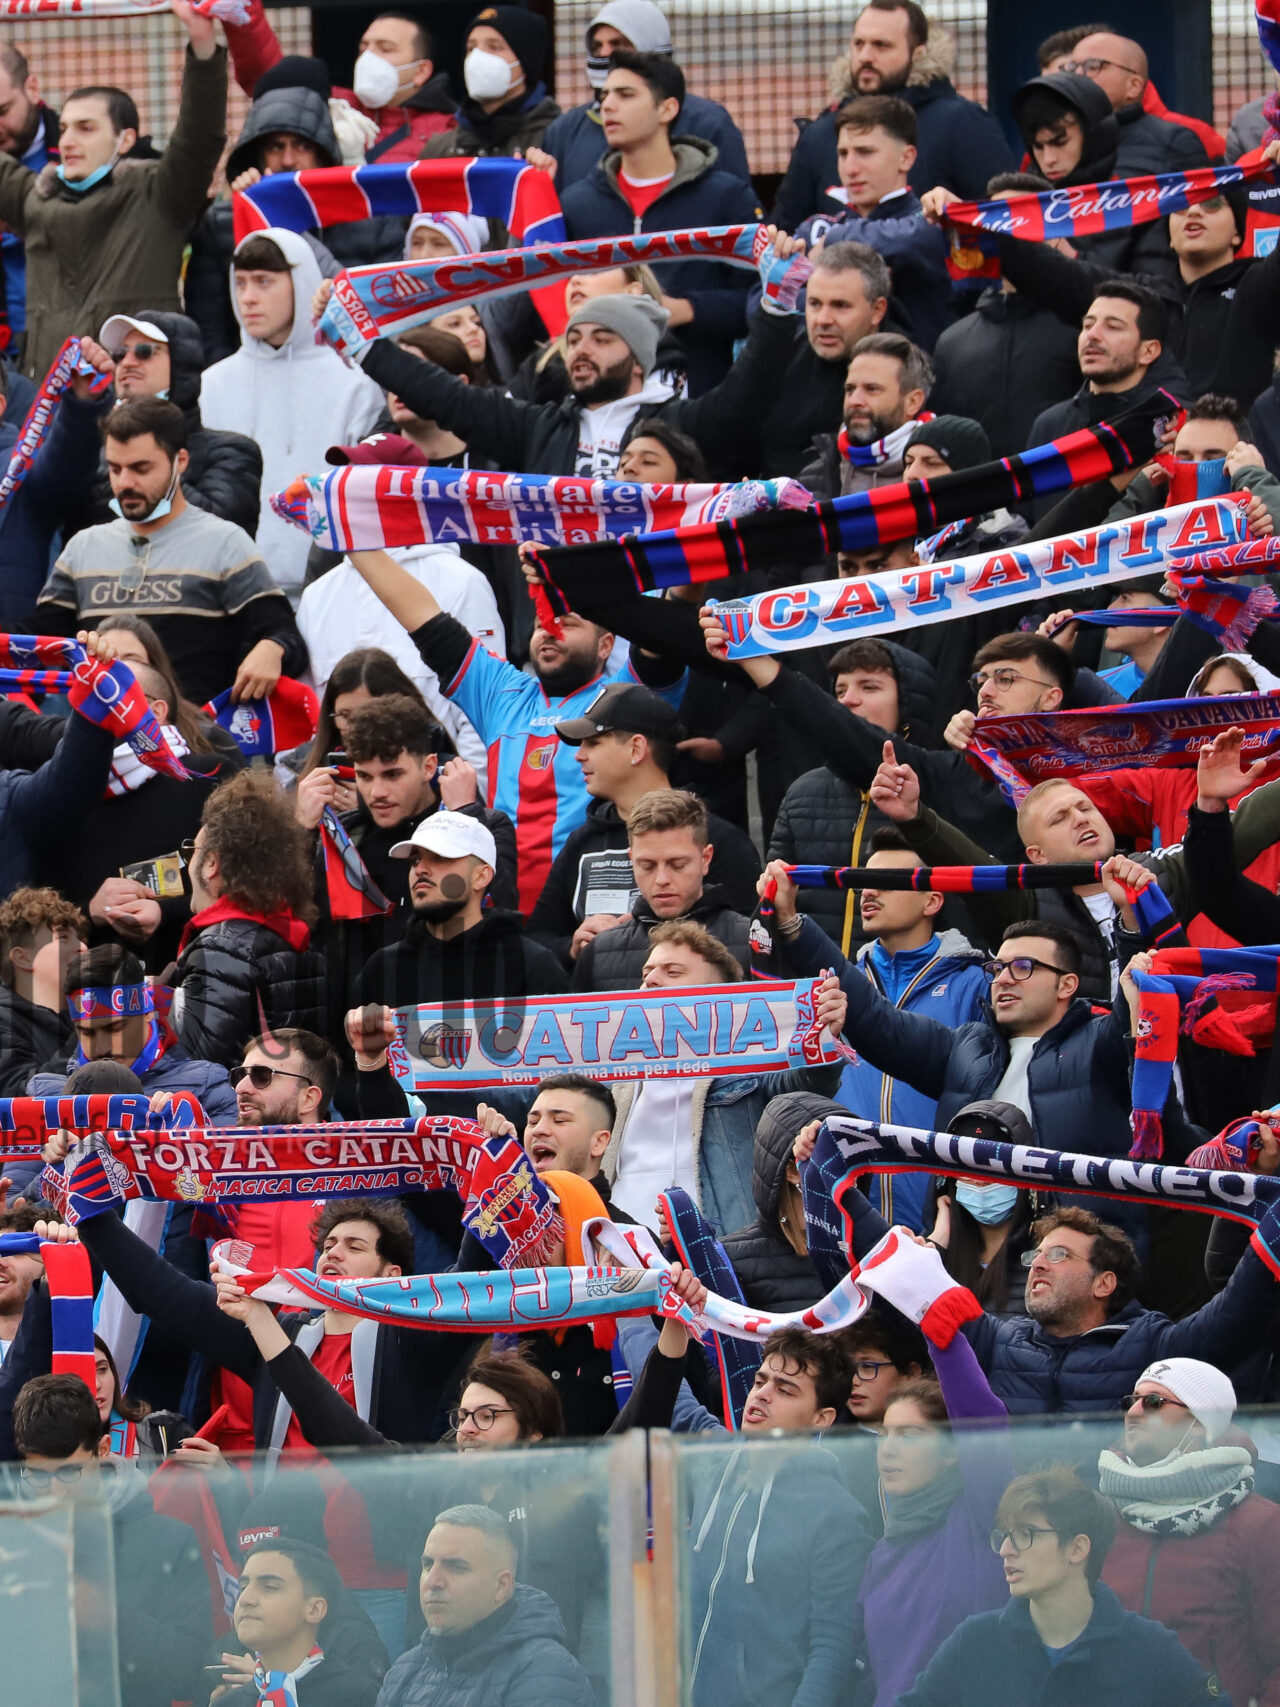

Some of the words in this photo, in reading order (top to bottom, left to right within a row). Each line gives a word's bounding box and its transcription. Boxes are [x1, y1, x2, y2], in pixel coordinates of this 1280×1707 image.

[755, 502, 1236, 640] CATANIA
[90, 579, 183, 604] GUESS
[478, 997, 778, 1068] CATANIA
[789, 991, 812, 1057] FORZA
[389, 1012, 410, 1078] FORZA
[502, 1067, 533, 1083] Non
[609, 1064, 638, 1078] ma
[644, 1063, 669, 1080] per
[676, 1061, 710, 1073] fede
[33, 1094, 90, 1130] TI
[133, 1139, 280, 1172] FORZA
[304, 1137, 482, 1173] CATANIA
[206, 1178, 294, 1198] MAGICA
[296, 1172, 400, 1193] CATANIA
[404, 1170, 437, 1185] OK
[486, 1181, 517, 1214] CATANESI
[498, 1187, 520, 1209] NASCE
